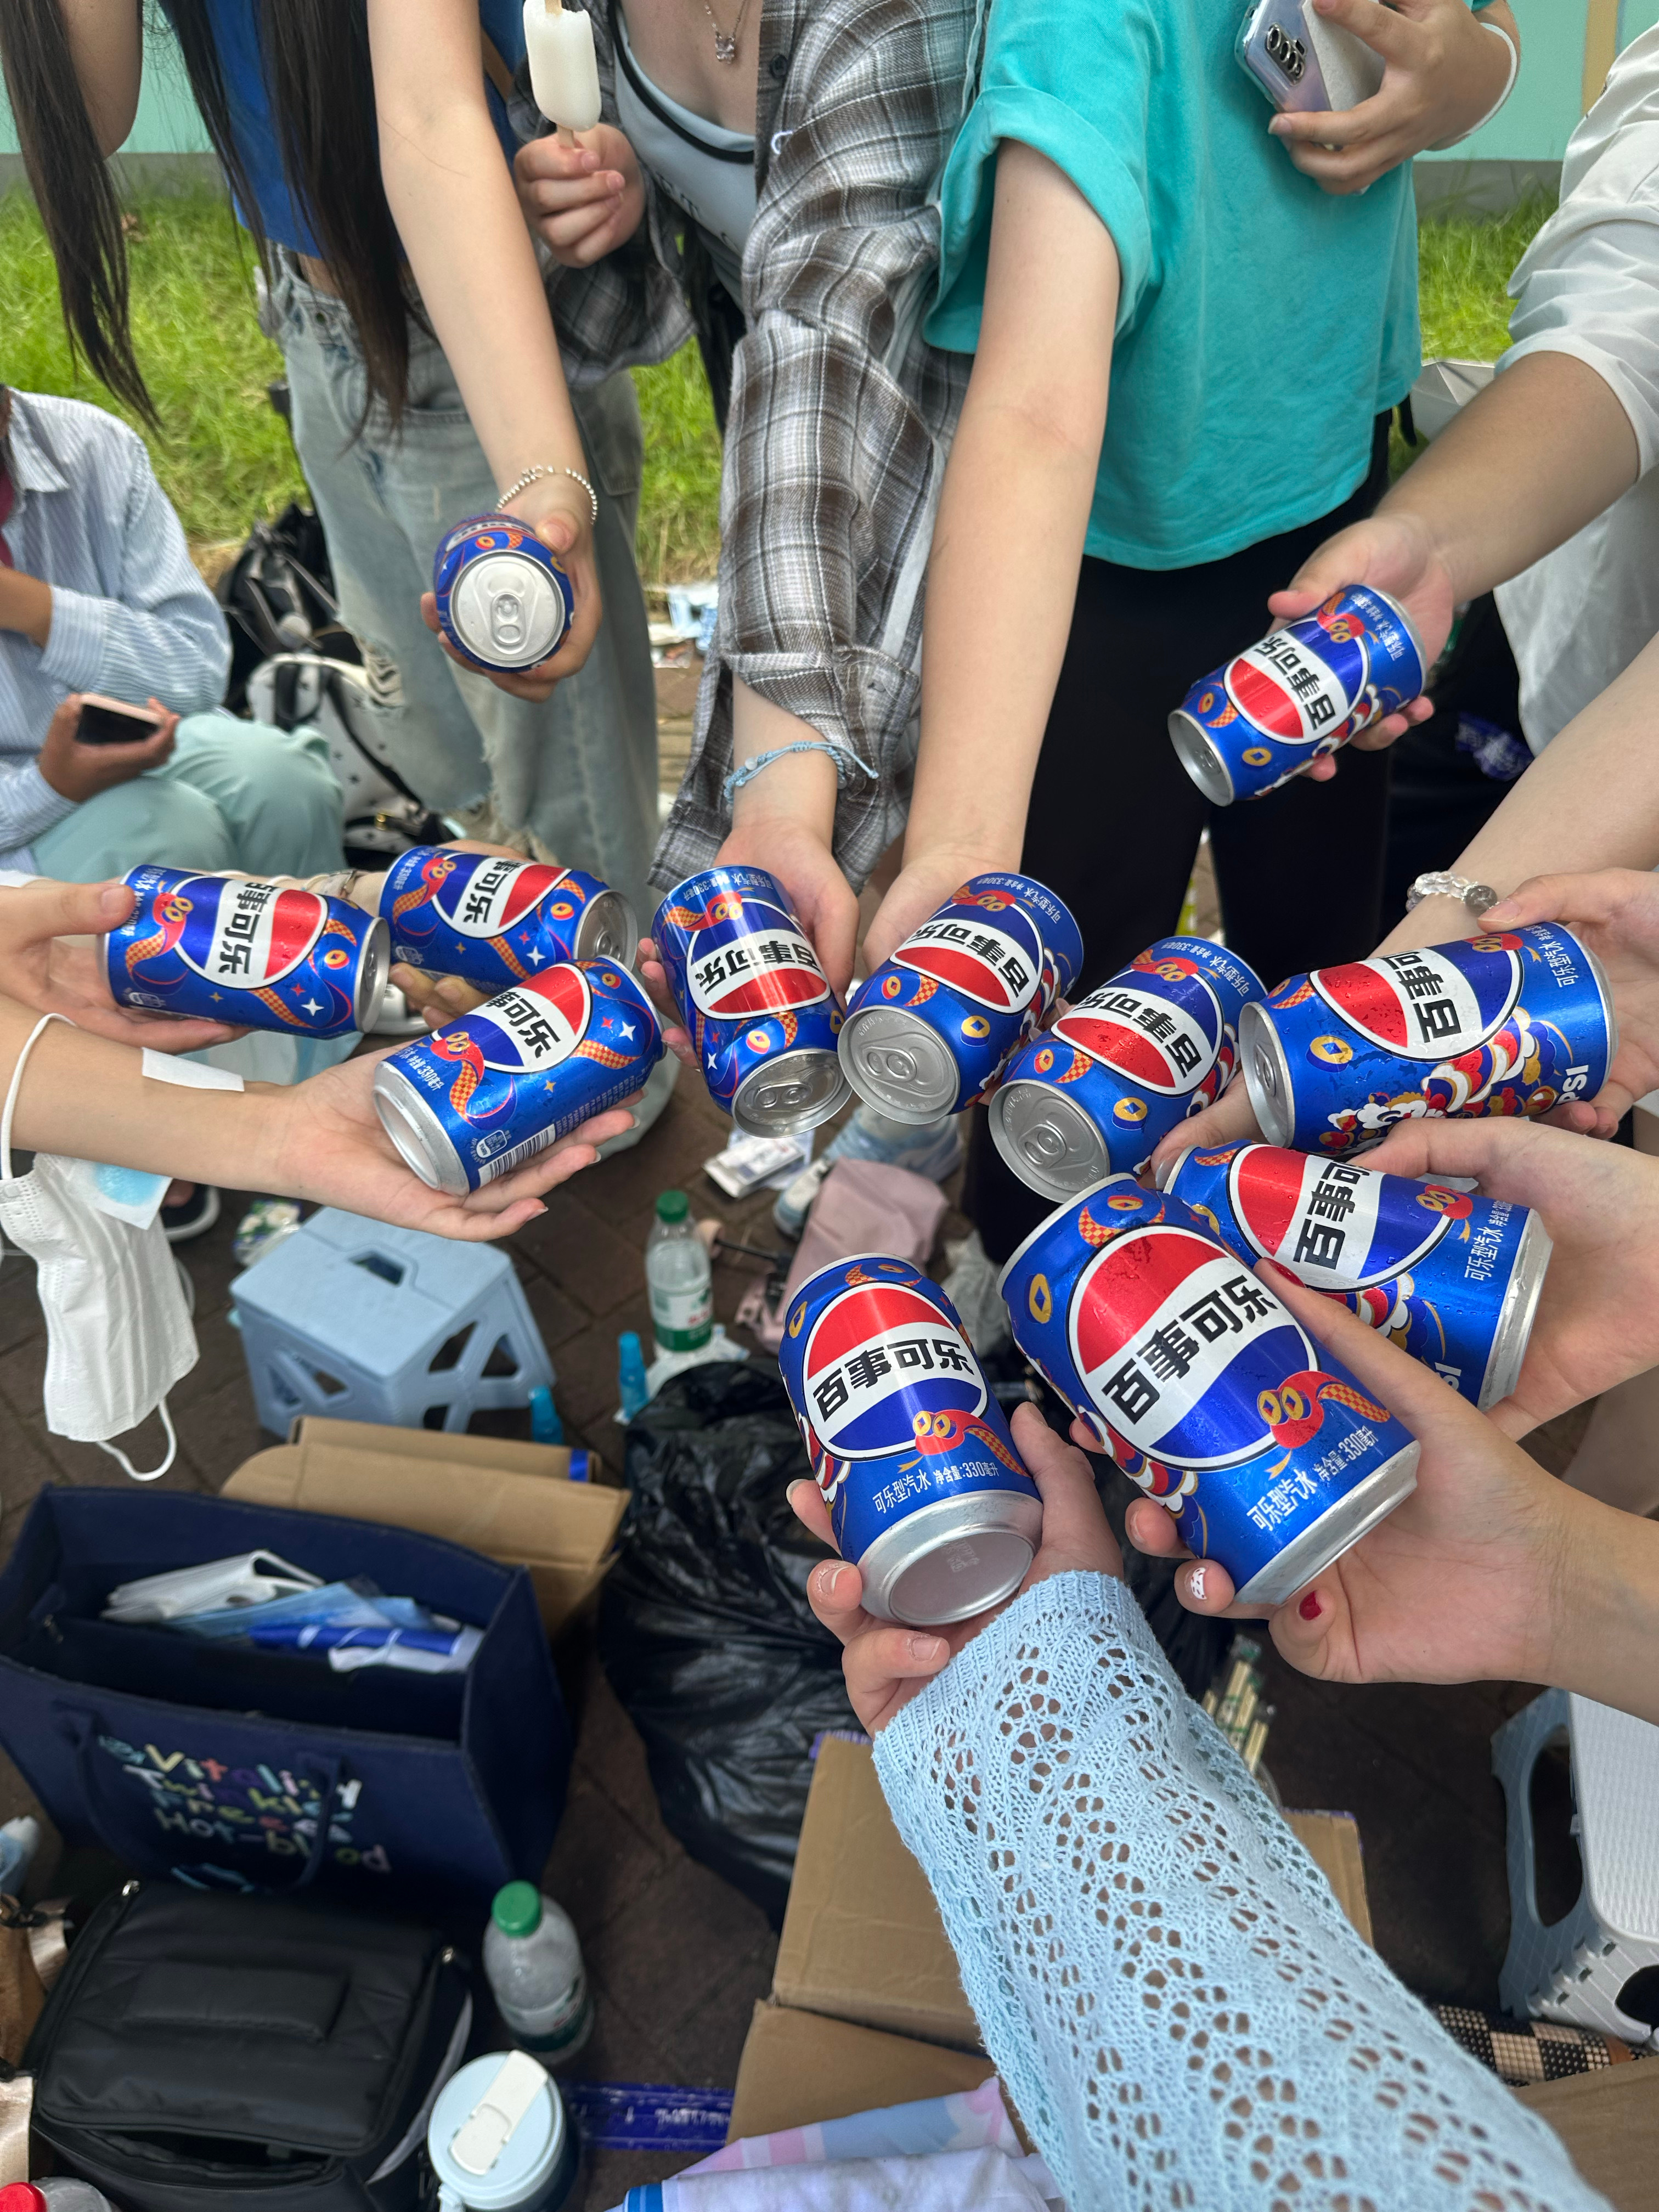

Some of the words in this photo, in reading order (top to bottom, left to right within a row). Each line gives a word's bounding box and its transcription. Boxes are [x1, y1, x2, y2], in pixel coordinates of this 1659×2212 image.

[1254, 636, 1335, 731] 百事可乐
[1024, 888, 1061, 924] 可乐型汽水
[695, 940, 822, 995] 百事可乐
[906, 924, 1030, 998] 百事可乐
[1209, 956, 1250, 997] 可乐型汽水
[1538, 941, 1579, 988] 可乐型汽水
[1072, 992, 1202, 1079] 百事可乐
[1293, 1161, 1370, 1270] 百事可
[1464, 1227, 1503, 1281] 可乐型汽水
[814, 1339, 974, 1423] 百事可乐
[1102, 1275, 1278, 1425] 百事可乐
[872, 1469, 932, 1514] 可乐型汽水
[933, 1461, 1000, 1485] 净含量:330毫升
[1246, 1469, 1318, 1532] 可乐型汽水
[1312, 1425, 1379, 1482] 净含量:330毫升
[154, 1807, 393, 1874] Hot-blod
